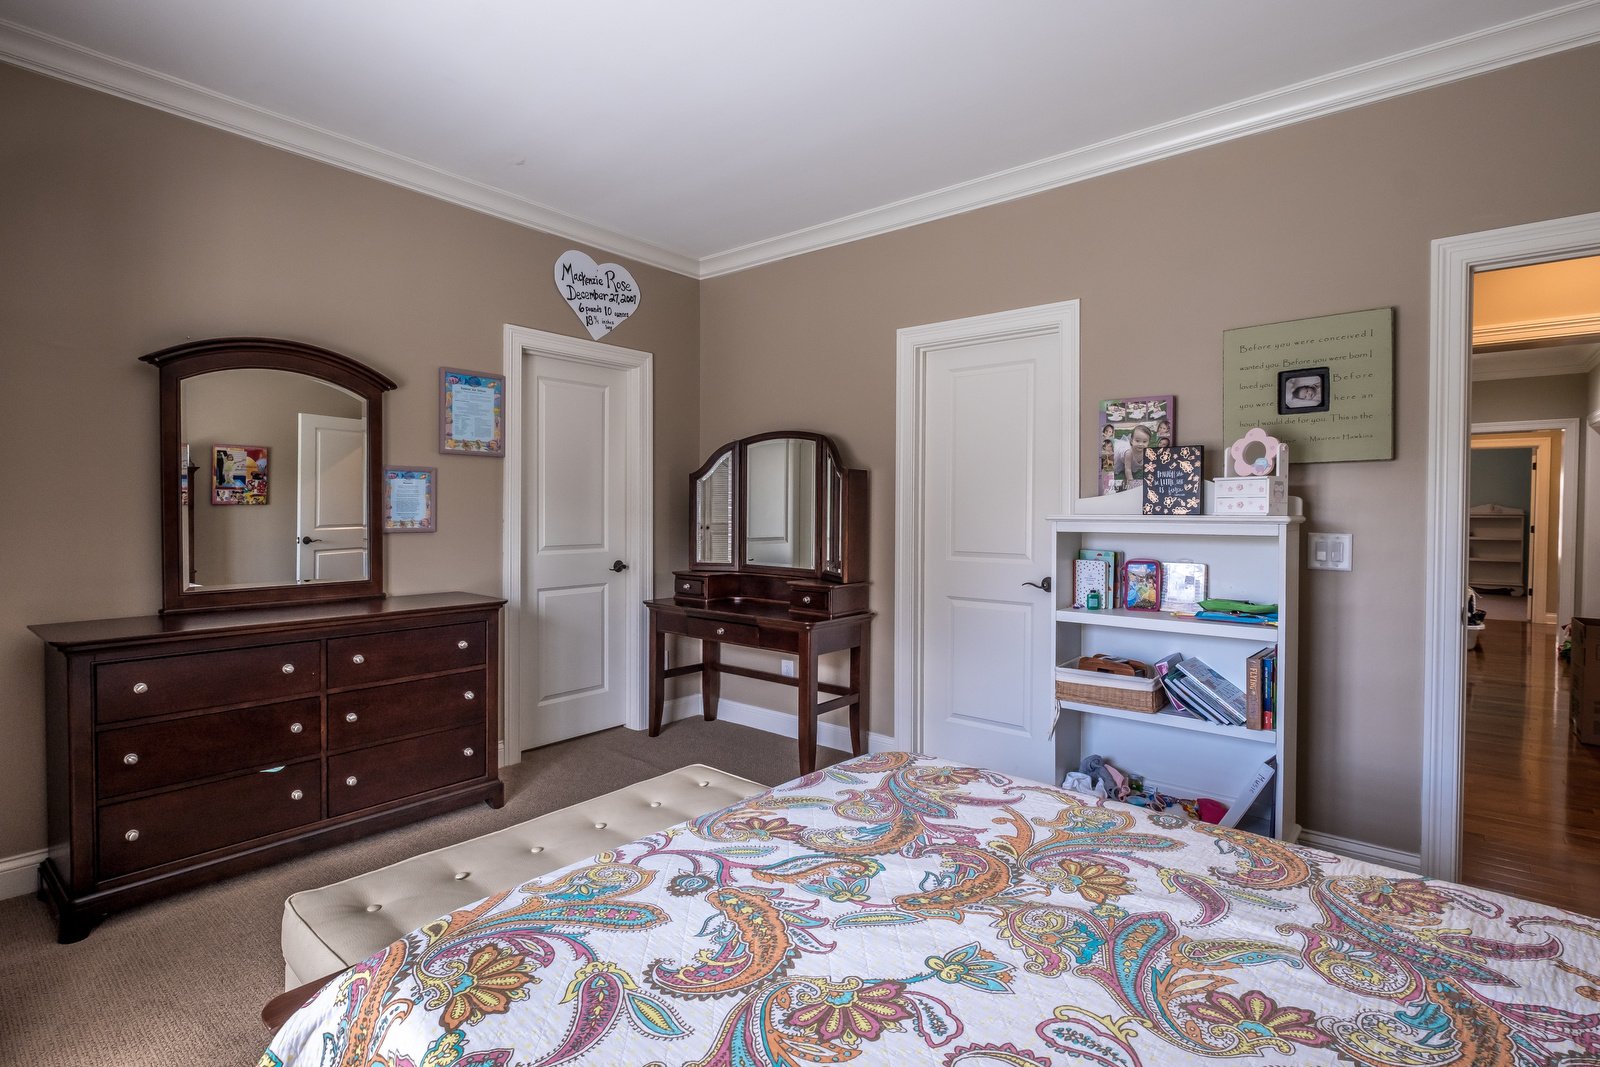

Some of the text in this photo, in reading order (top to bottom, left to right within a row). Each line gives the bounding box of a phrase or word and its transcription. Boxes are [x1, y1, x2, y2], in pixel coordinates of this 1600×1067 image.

[561, 263, 632, 292] Mackenzie Rose
[566, 285, 609, 300] December
[579, 303, 585, 313] 6
[604, 306, 613, 316] 10
[1239, 343, 1271, 354] Before
[1274, 342, 1291, 351] you
[1318, 329, 1367, 343] conceived
[1239, 361, 1265, 371] wanted
[1282, 358, 1311, 368] Before
[1349, 351, 1368, 359] born
[1239, 381, 1258, 390] loved
[1332, 371, 1373, 382] Before
[1333, 393, 1357, 401] here
[1261, 417, 1283, 426] would
[1284, 417, 1296, 425] die
[1330, 412, 1350, 423] This
[1360, 411, 1374, 420] the
[1342, 432, 1374, 441] Hawkins
[1249, 667, 1258, 690] FLYING
